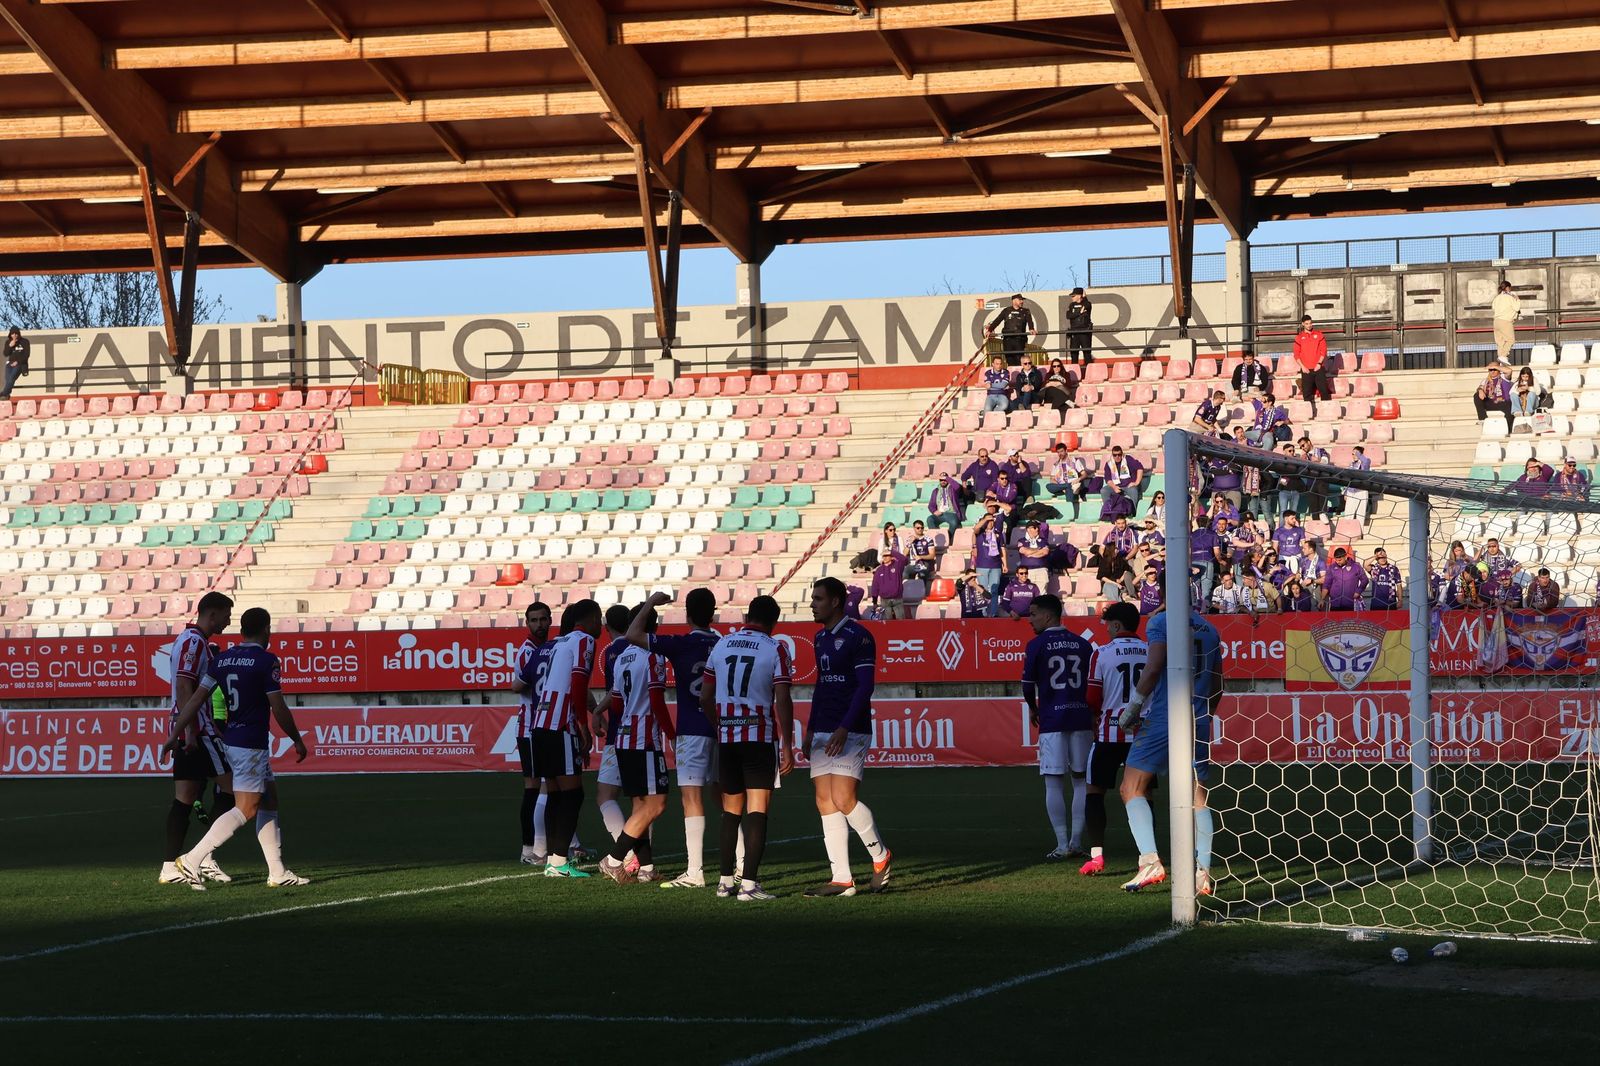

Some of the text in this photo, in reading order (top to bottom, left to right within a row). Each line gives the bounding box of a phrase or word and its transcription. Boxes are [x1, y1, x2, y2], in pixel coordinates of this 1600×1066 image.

[558, 311, 691, 375] DE
[725, 292, 1225, 368] ZAMORA
[987, 638, 1018, 651] Grupo
[50, 659, 138, 678] cruces
[278, 654, 358, 673] ruces
[384, 655, 400, 669] la
[462, 669, 489, 684] de
[725, 655, 755, 697] 17
[1048, 655, 1081, 690] 23
[58, 680, 92, 688] Benavente
[226, 673, 239, 711] 5
[6, 715, 103, 735] CLÍNICA
[314, 724, 473, 744] VALDERADUEY
[1290, 697, 1505, 760] La Opnión
[3, 737, 74, 771] JOSÉ
[78, 745, 113, 771] DE
[328, 748, 369, 756] CENTRO
[436, 747, 475, 755] ZAMORA
[878, 751, 935, 762] Zamora
[1306, 747, 1322, 757] El
[1326, 747, 1380, 758] Correo
[1429, 747, 1480, 757] amora
